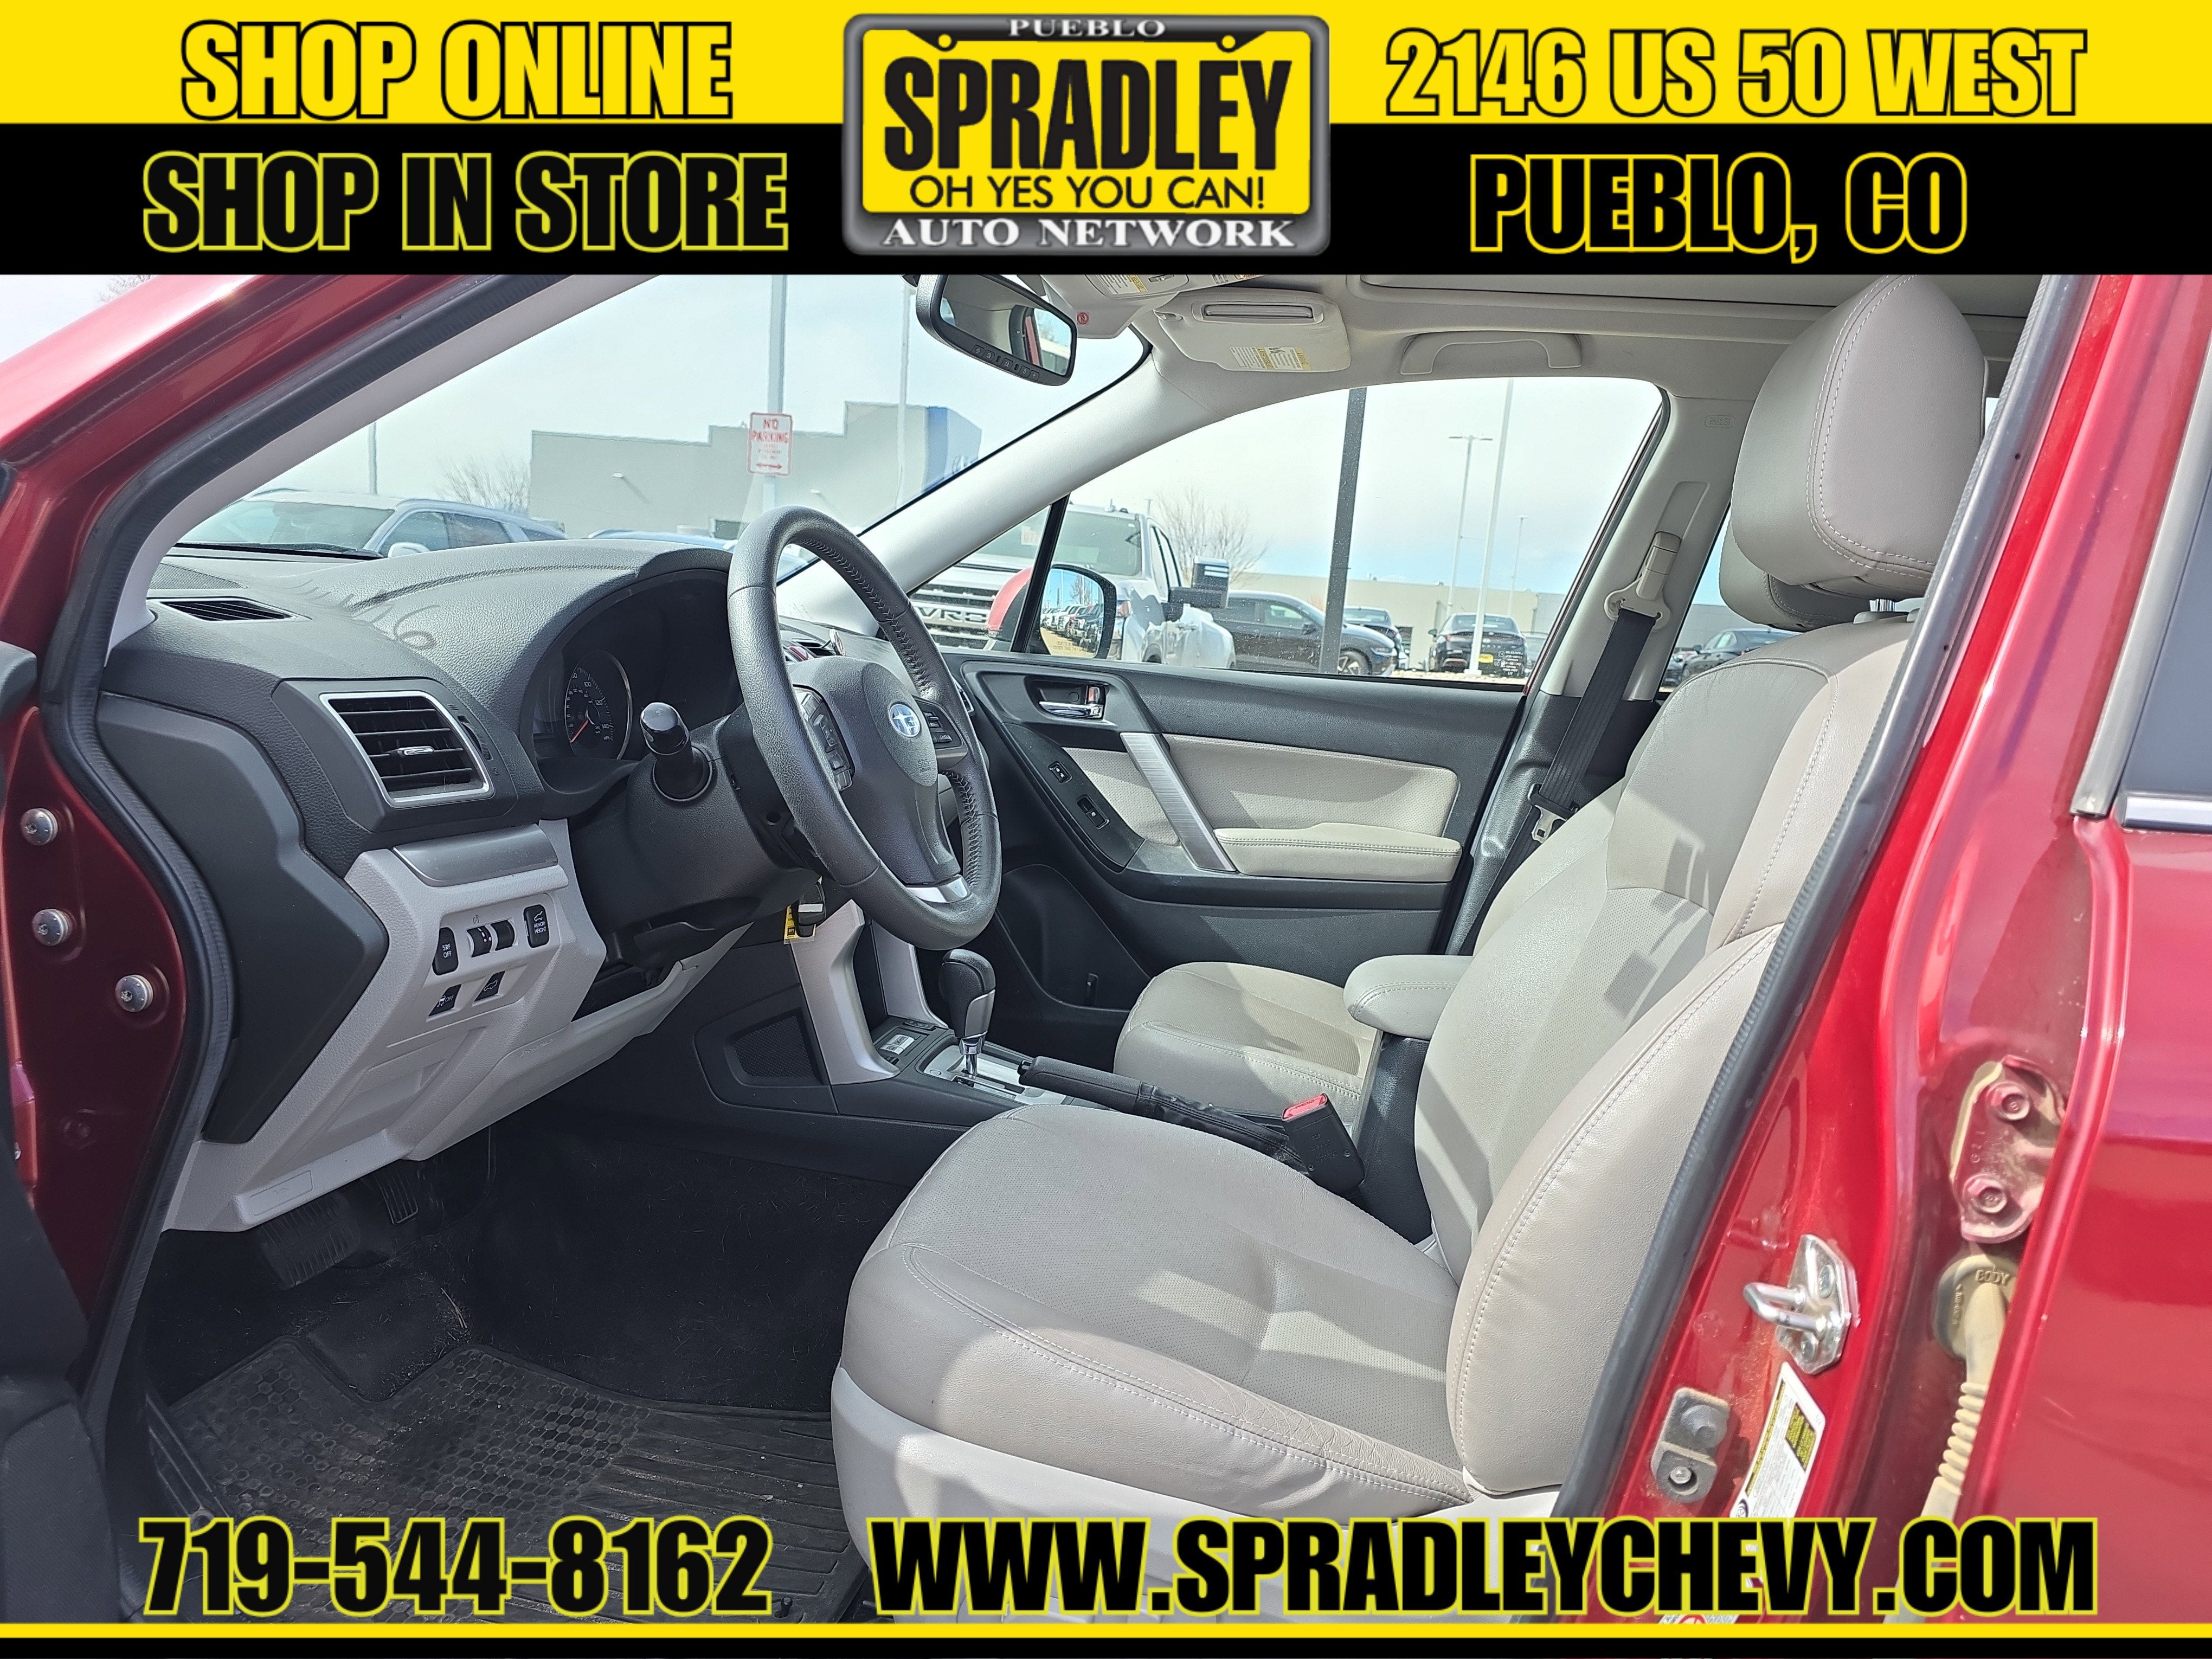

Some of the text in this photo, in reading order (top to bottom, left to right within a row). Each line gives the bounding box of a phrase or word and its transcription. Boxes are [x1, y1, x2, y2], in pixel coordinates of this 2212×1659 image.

[762, 419, 779, 429] NO
[442, 943, 451, 951] SRF
[1975, 1270, 2010, 1285] BODY
